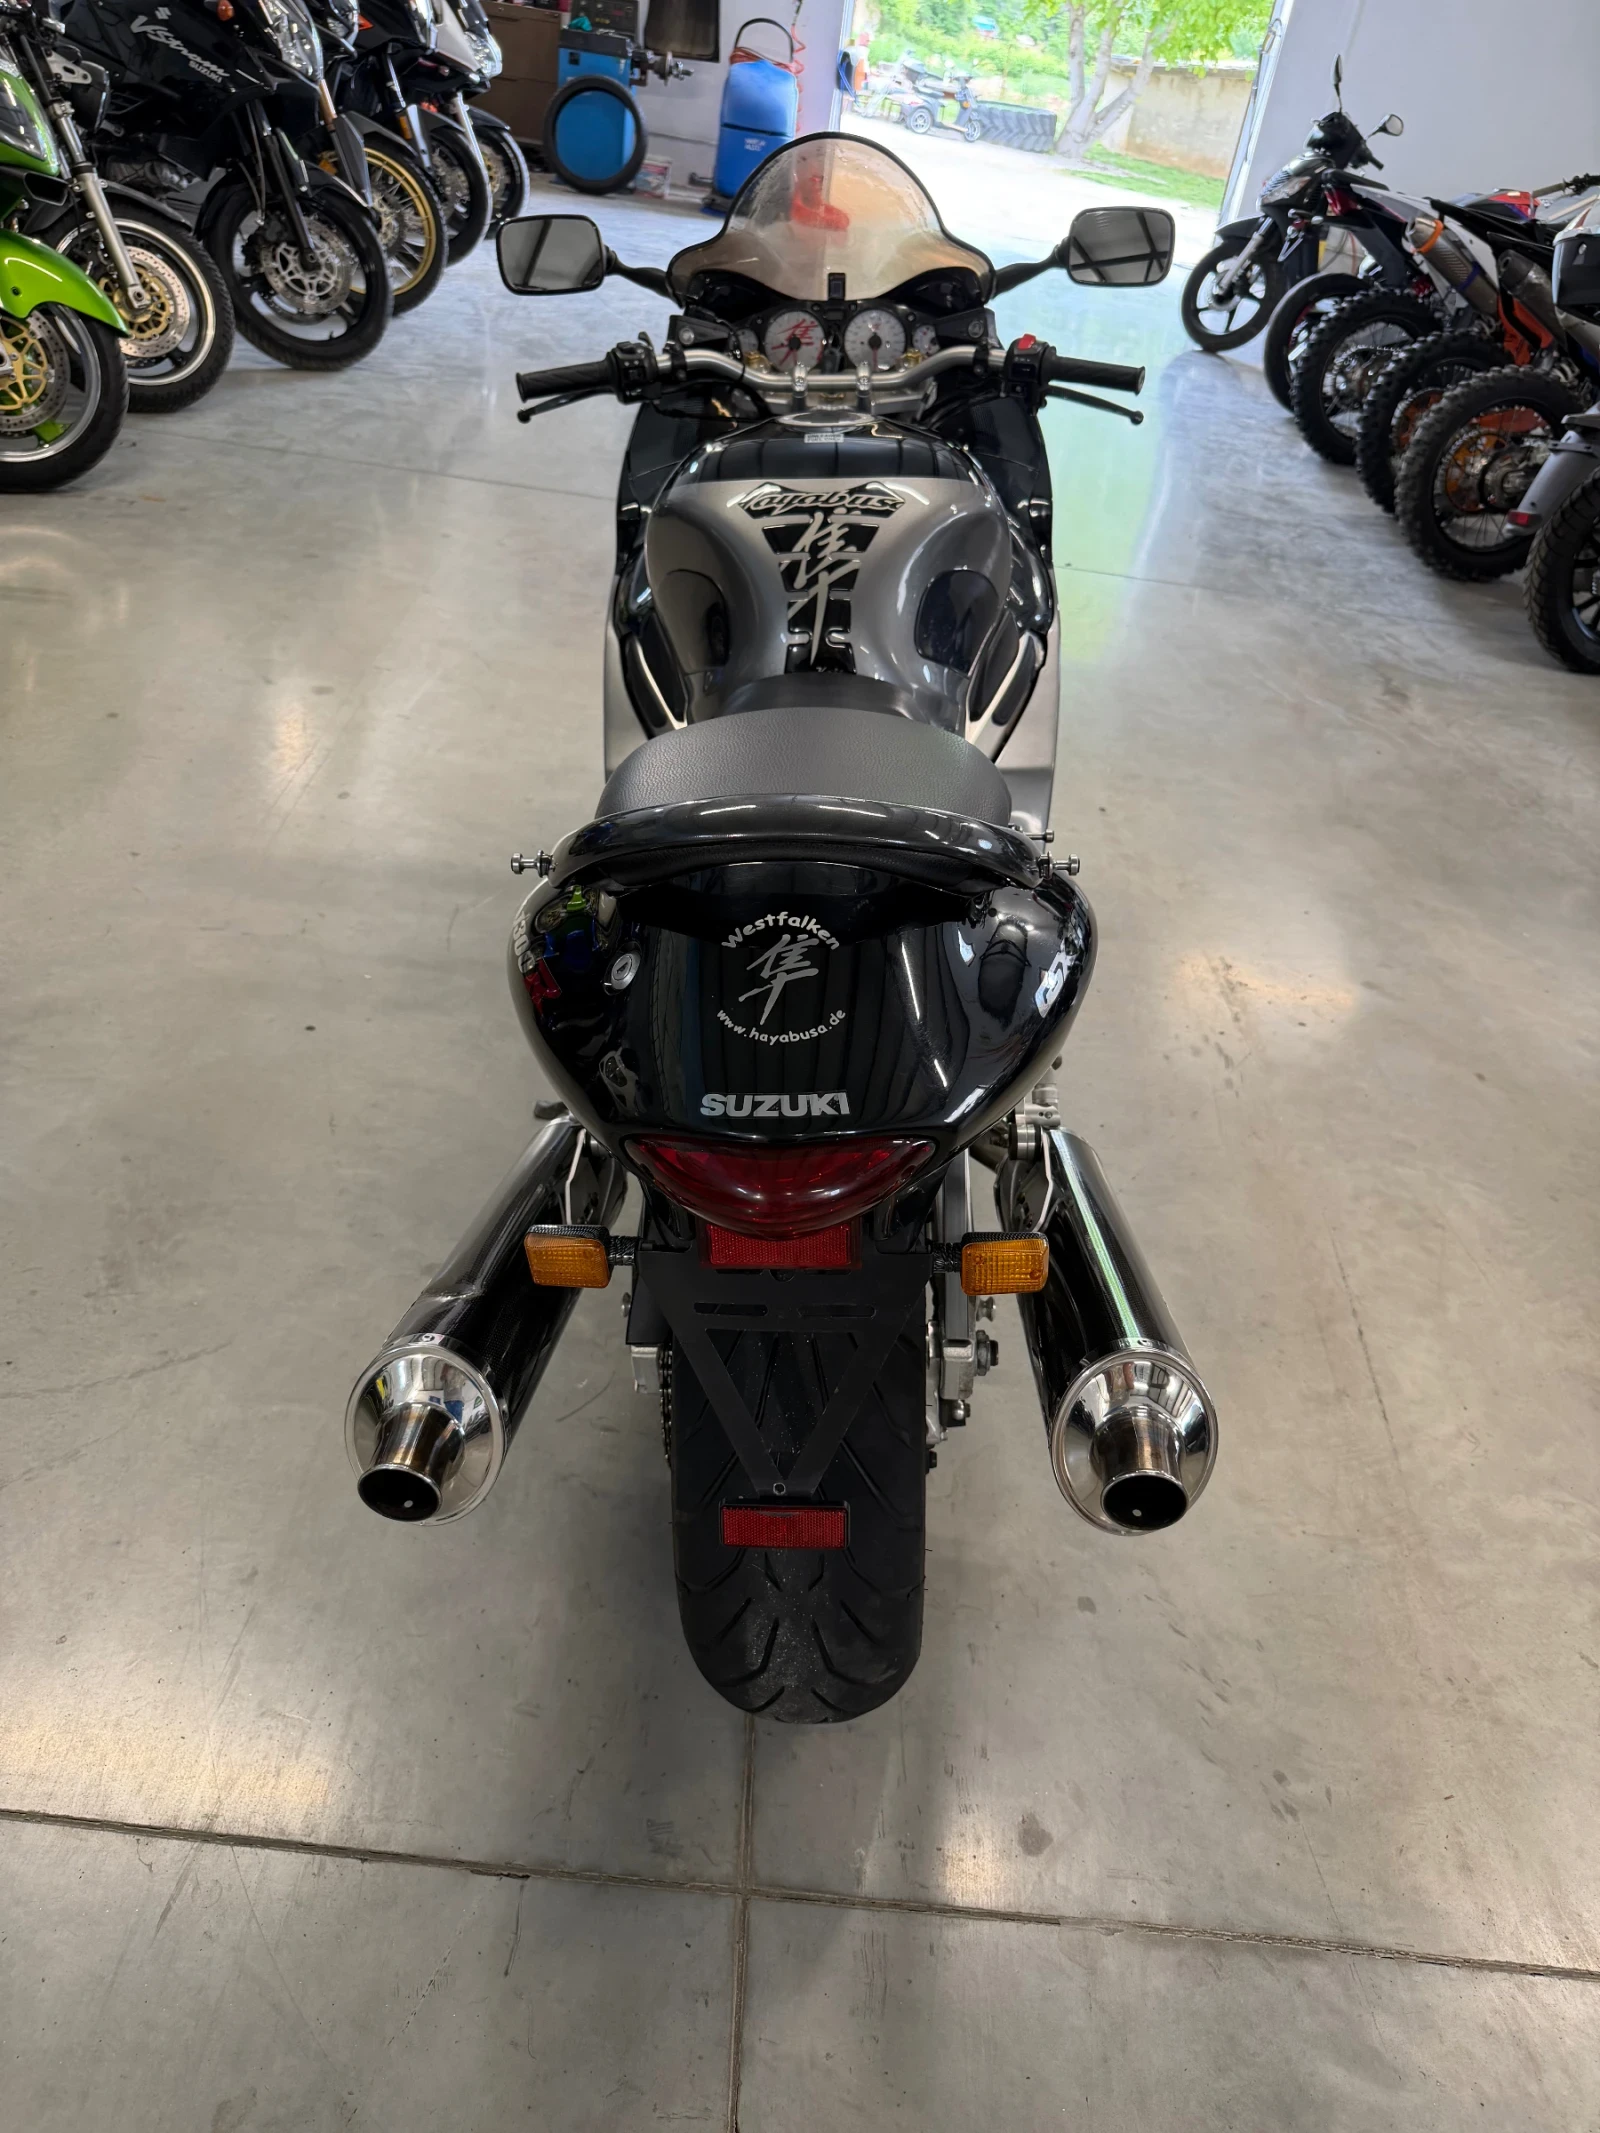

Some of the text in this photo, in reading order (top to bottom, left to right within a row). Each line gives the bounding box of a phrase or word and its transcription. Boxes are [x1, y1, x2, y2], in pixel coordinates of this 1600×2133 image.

[188, 60, 222, 83] SUZUKI
[721, 911, 840, 950] Westfalken
[717, 1009, 846, 1046] www.hayabusa.de
[700, 1092, 850, 1117] SUZUKI
